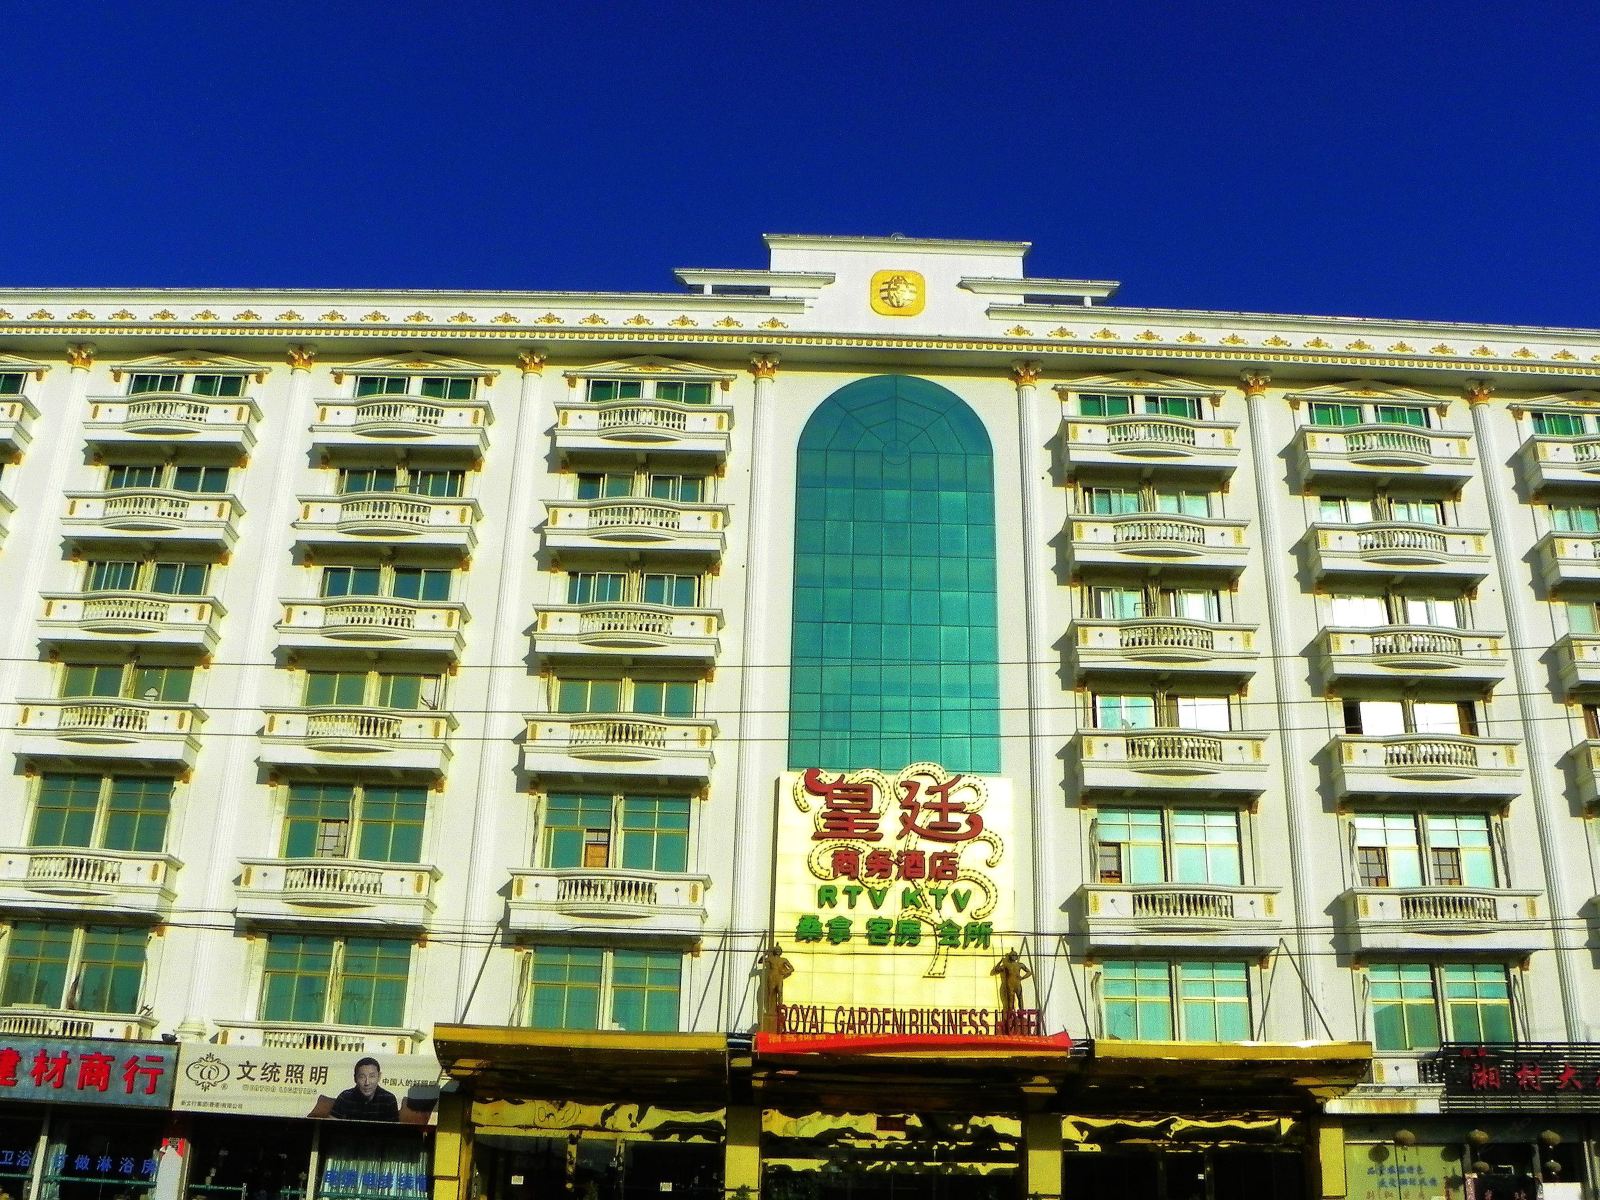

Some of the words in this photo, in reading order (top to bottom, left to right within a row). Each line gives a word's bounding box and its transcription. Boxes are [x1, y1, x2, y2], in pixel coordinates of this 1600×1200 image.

[804, 768, 984, 842] 皇廷
[831, 849, 960, 881] 商务酒店
[817, 885, 889, 909] RTV
[901, 887, 972, 912] KTV
[795, 914, 853, 945] 桑拿
[865, 916, 922, 947] 客房
[938, 919, 994, 949] 会所
[777, 1004, 829, 1035] ROYAL
[835, 1006, 907, 1036] GARDEN
[910, 1008, 990, 1037] BUSINESS
[236, 1060, 329, 1086] 文统照明
[1471, 1063, 1600, 1092] 湘村大
